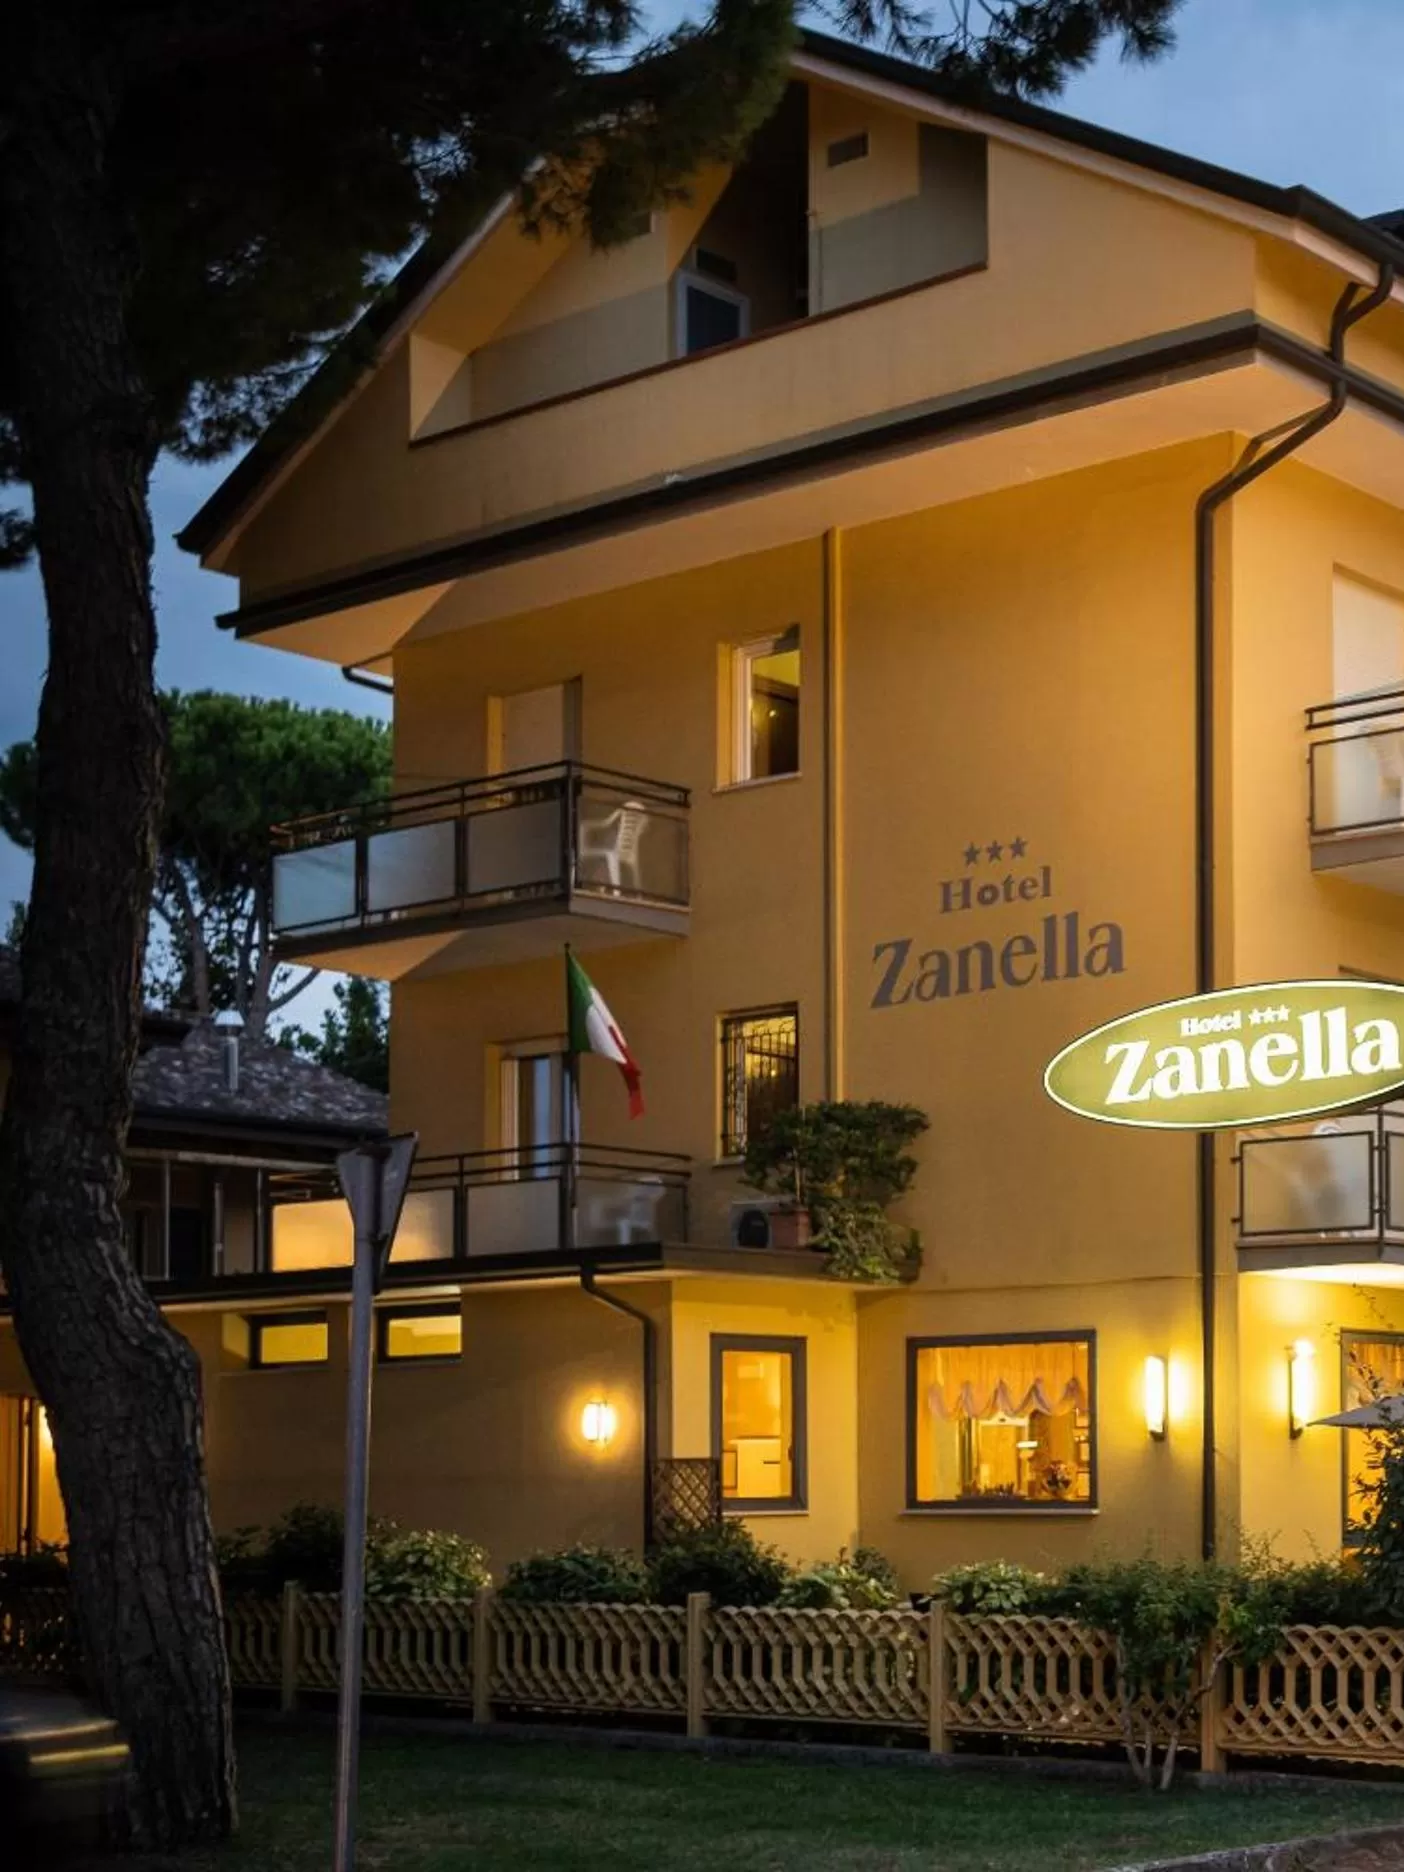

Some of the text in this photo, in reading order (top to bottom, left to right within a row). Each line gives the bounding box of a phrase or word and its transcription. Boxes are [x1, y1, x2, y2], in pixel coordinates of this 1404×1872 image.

[940, 866, 1052, 913] Hotel
[870, 911, 1127, 1008] Zanella
[1105, 1007, 1402, 1105] Zanella
[1181, 1011, 1242, 1036] Hotel
